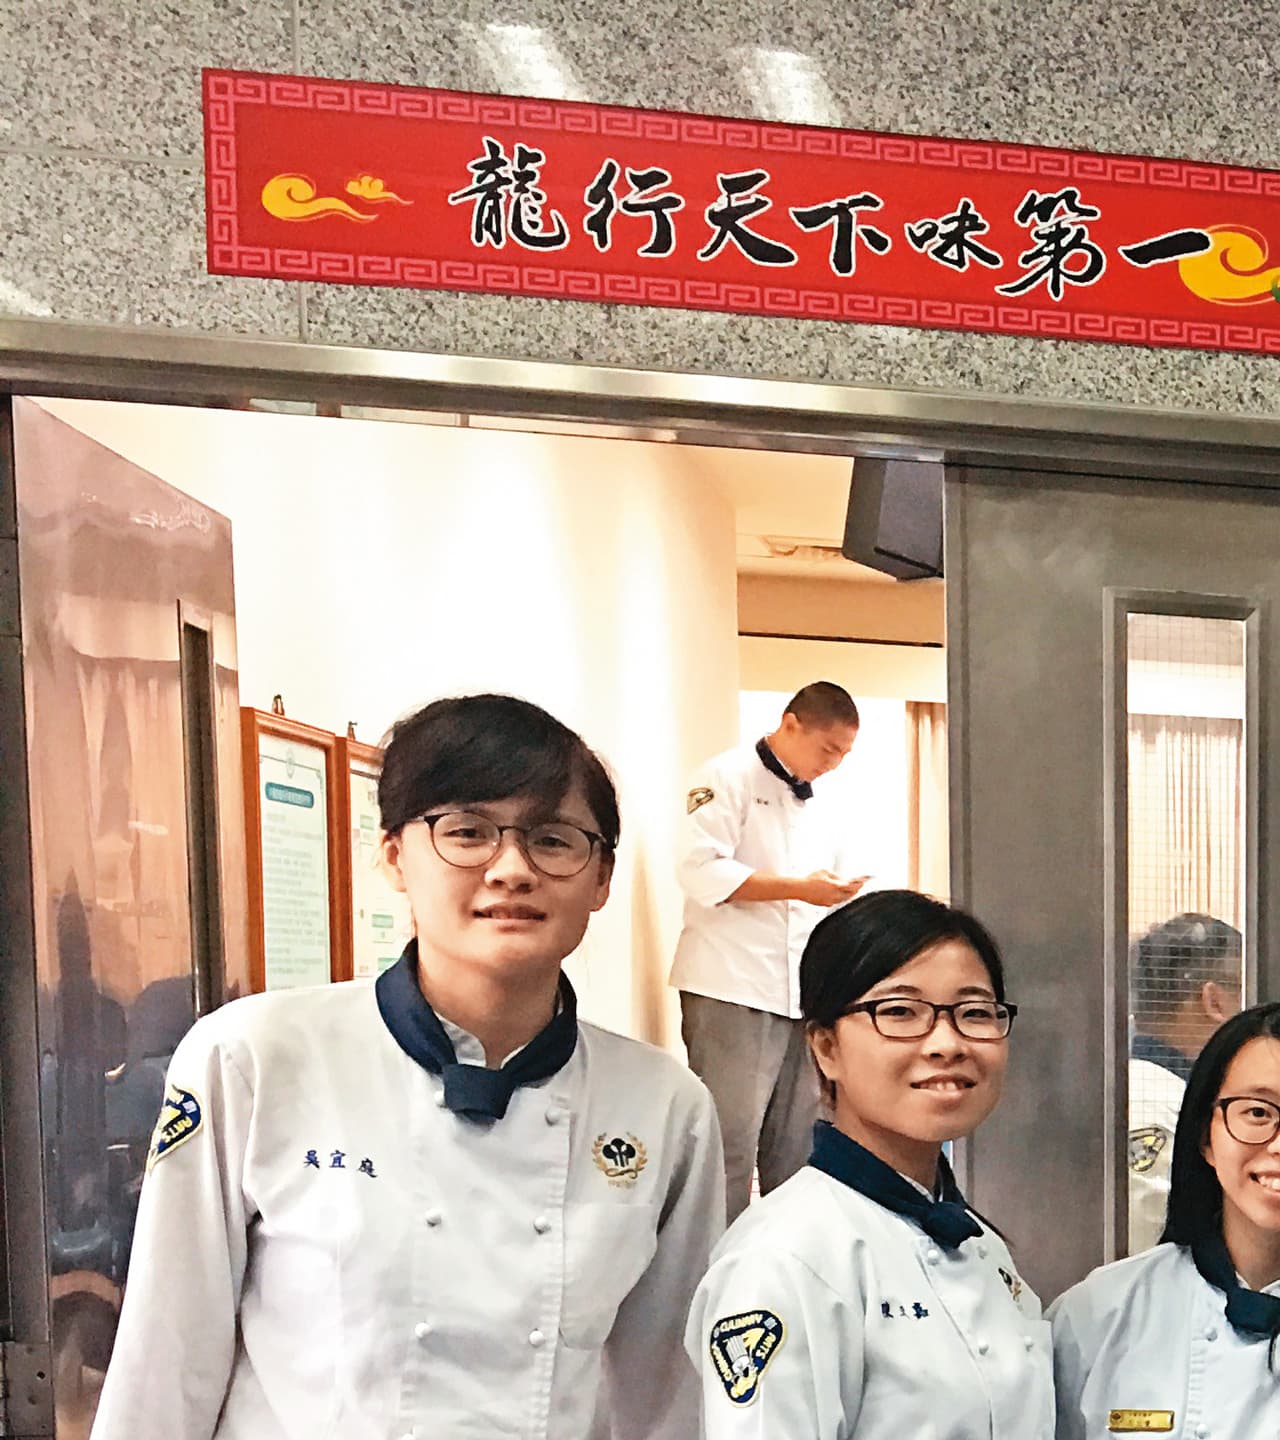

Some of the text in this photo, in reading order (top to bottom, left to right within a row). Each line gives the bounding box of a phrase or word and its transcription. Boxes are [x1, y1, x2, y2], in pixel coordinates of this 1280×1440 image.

[448, 135, 1212, 302] 龍行天下味第一
